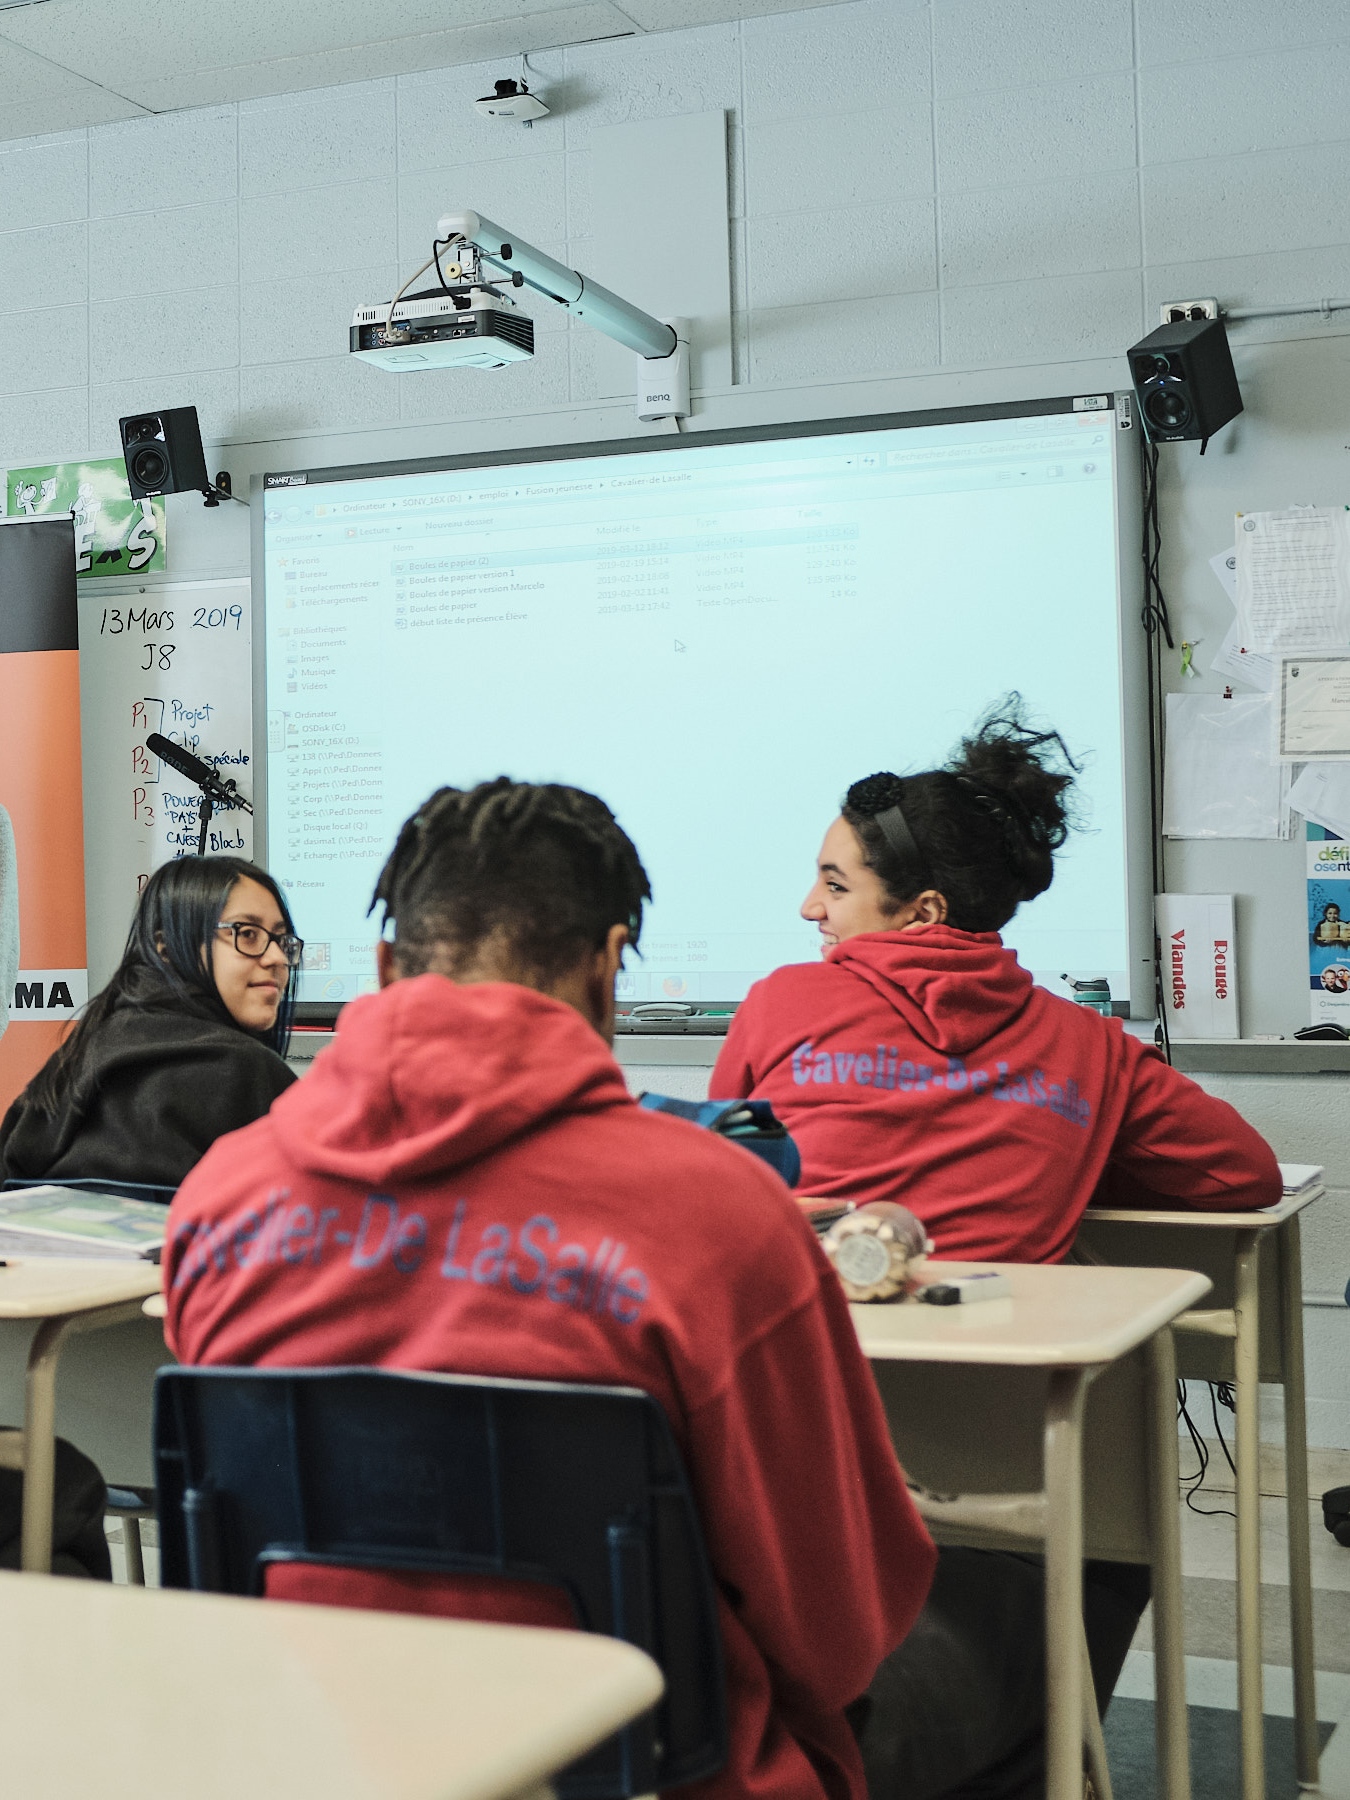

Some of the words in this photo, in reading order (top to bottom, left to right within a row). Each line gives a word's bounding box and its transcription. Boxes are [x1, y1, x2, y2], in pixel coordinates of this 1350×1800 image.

[267, 476, 290, 486] SMART
[343, 503, 386, 513] Ordinateur
[479, 491, 509, 501] emploi
[526, 487, 554, 496] Fusion
[555, 483, 593, 494] jeunesse
[359, 526, 390, 536] Lecture
[425, 520, 463, 530] Nouveau
[464, 517, 494, 526] dossier
[292, 557, 320, 566] Favoris
[409, 561, 436, 571] Boules
[438, 558, 449, 568] de
[450, 557, 476, 569] papier
[478, 556, 490, 566] (2)
[300, 571, 327, 579] Bureau
[409, 575, 437, 585] Boules
[439, 574, 450, 583] de
[450, 573, 477, 584] papier
[478, 570, 509, 580] version
[300, 581, 358, 593] Emplacements
[409, 590, 437, 599] Boules
[438, 588, 450, 597] de
[450, 587, 477, 598] papier
[478, 584, 509, 593] version
[510, 581, 545, 591] Marcelo
[301, 595, 368, 607] Téléchargements
[409, 604, 437, 614] Boules
[438, 603, 450, 611] de
[451, 601, 478, 612] papier
[100, 608, 124, 635] 13
[127, 607, 174, 634] Mars
[191, 604, 243, 631] 2019
[410, 618, 435, 628] début
[436, 617, 452, 626] liste
[454, 615, 466, 625] de
[466, 613, 504, 626] présence
[293, 625, 347, 636] Bibliothèques
[301, 639, 346, 649] Documents
[141, 643, 176, 671] J8
[301, 655, 330, 664] Images
[301, 668, 336, 678] Musique
[171, 699, 214, 729] Projet
[294, 711, 337, 719] Ordinateur
[132, 745, 153, 775] P2
[302, 781, 330, 790] Projets
[303, 796, 322, 804] Corp
[133, 787, 154, 827] P3
[303, 823, 330, 833] Disque
[332, 822, 351, 830] local
[166, 831, 201, 847] CNESS
[296, 880, 325, 888] Réseau
[686, 940, 708, 949] 1920
[686, 953, 708, 962] 1080
[1170, 928, 1186, 1010] Viandes
[1213, 940, 1228, 1000] Rouge
[439, 1199, 650, 1325] LaSalle
